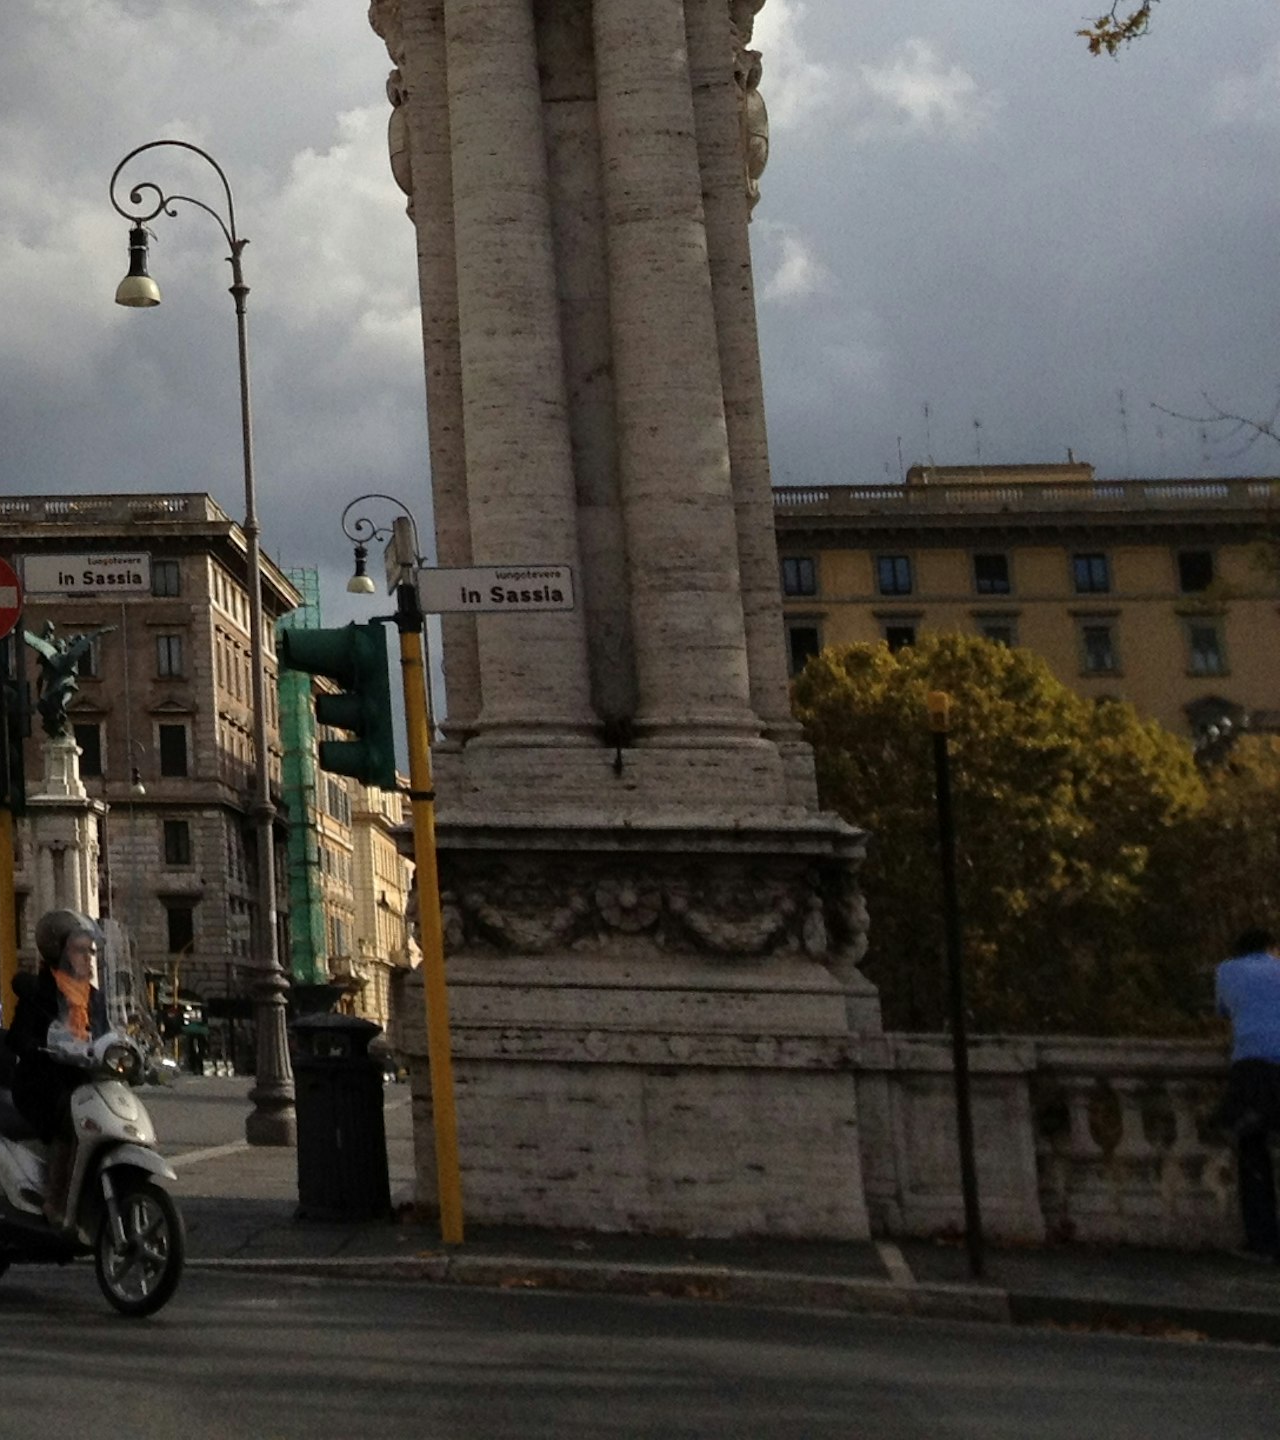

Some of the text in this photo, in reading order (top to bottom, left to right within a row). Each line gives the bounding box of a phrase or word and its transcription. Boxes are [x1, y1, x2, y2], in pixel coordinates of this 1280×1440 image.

[58, 570, 142, 585] in Sassia
[461, 585, 564, 603] in Sassia
